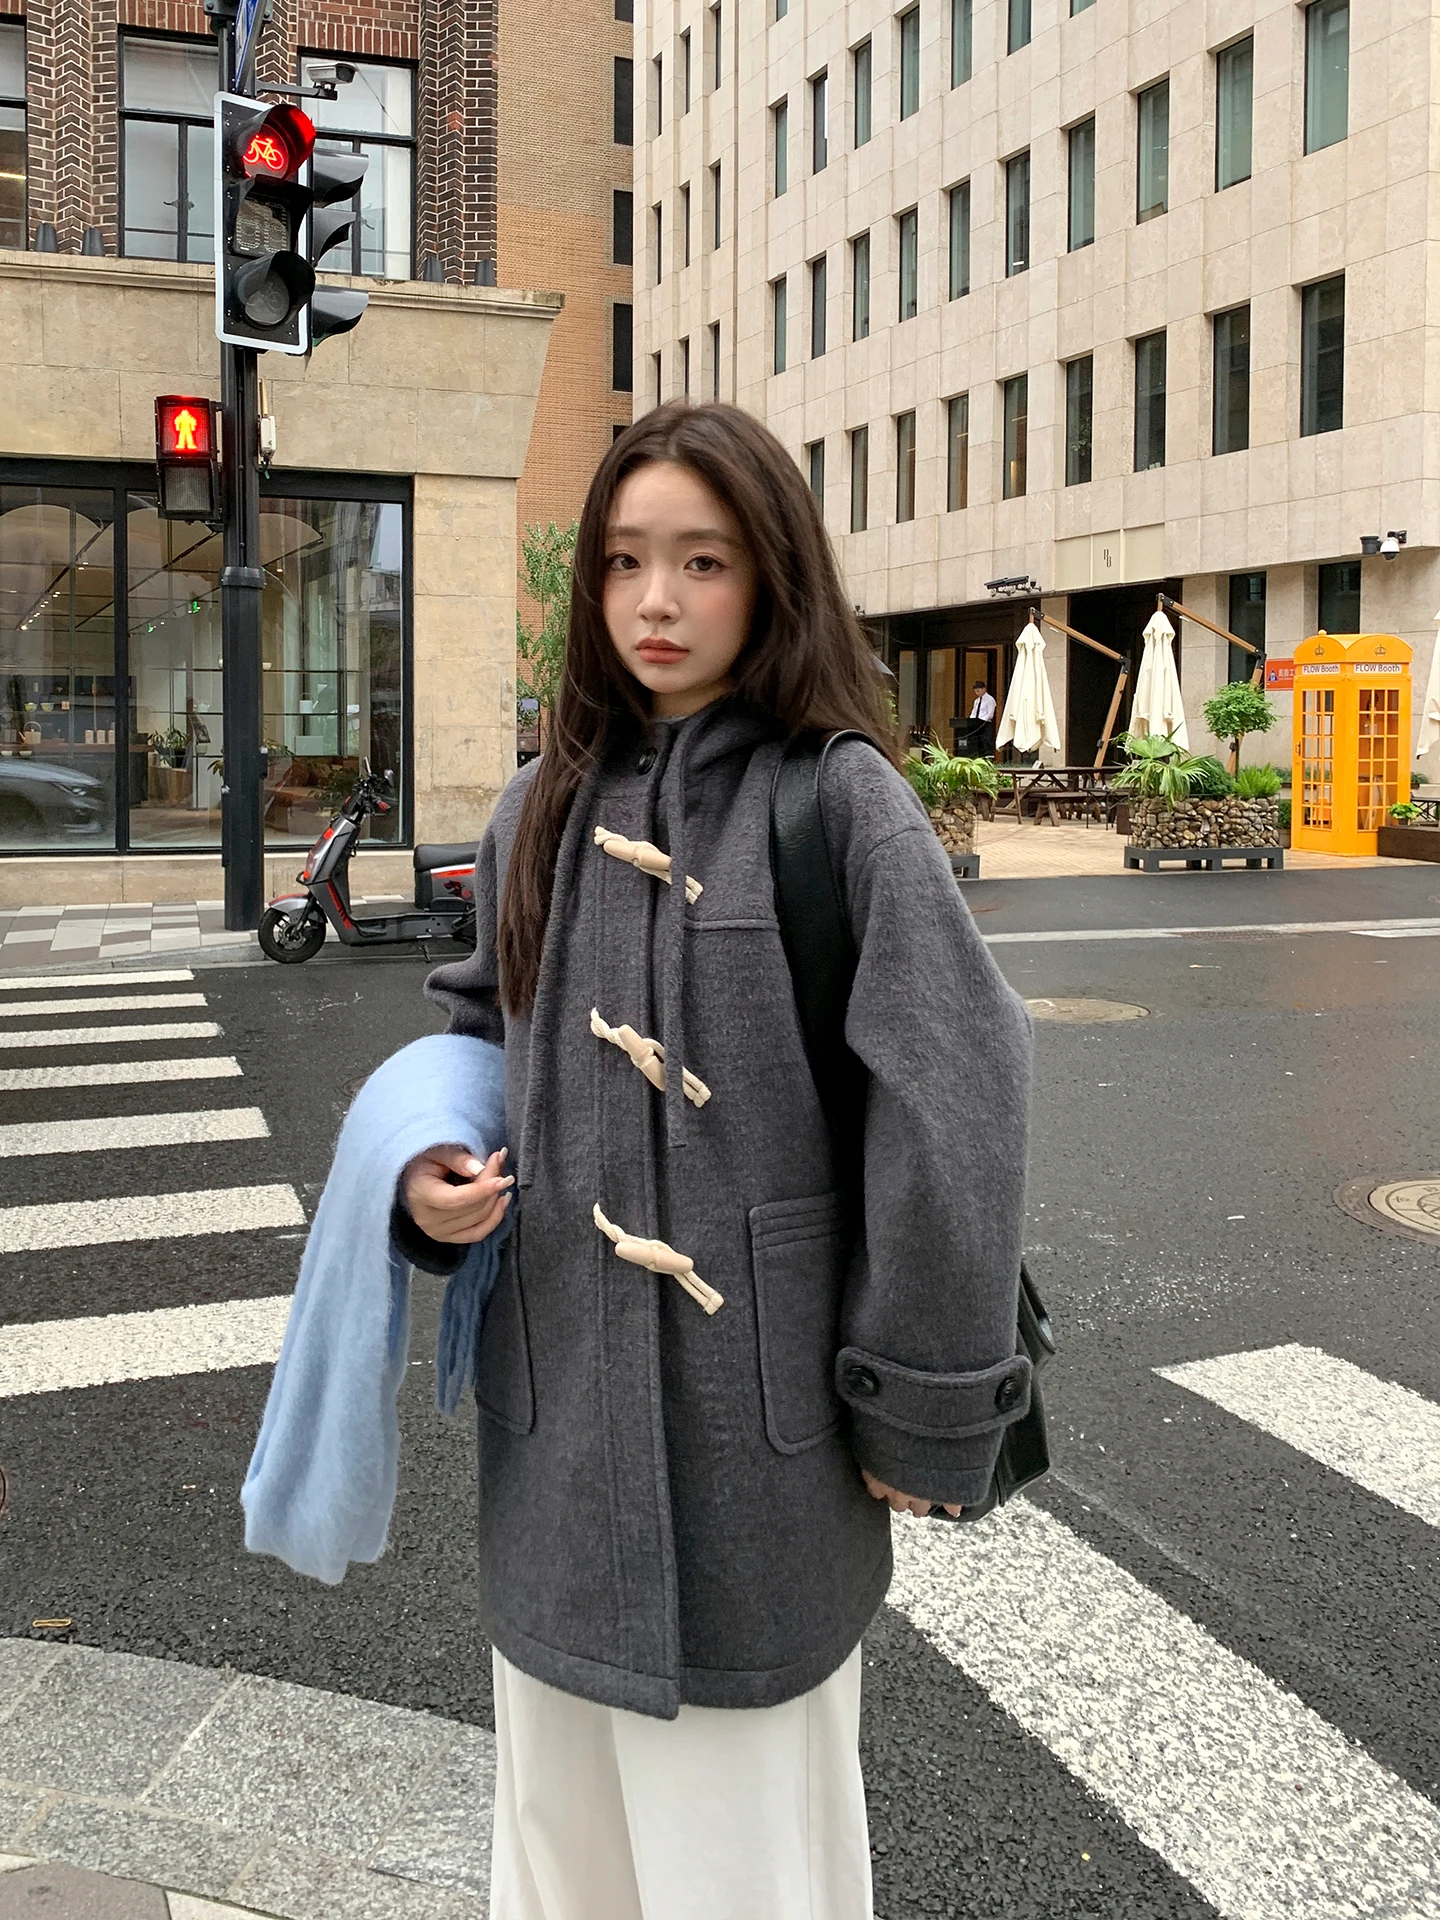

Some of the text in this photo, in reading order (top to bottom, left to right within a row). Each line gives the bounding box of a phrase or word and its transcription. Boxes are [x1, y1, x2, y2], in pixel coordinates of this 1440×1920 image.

[1303, 665, 1320, 673] FLOW
[1321, 665, 1339, 673] Booth
[1355, 663, 1400, 672] FLOW Booth
